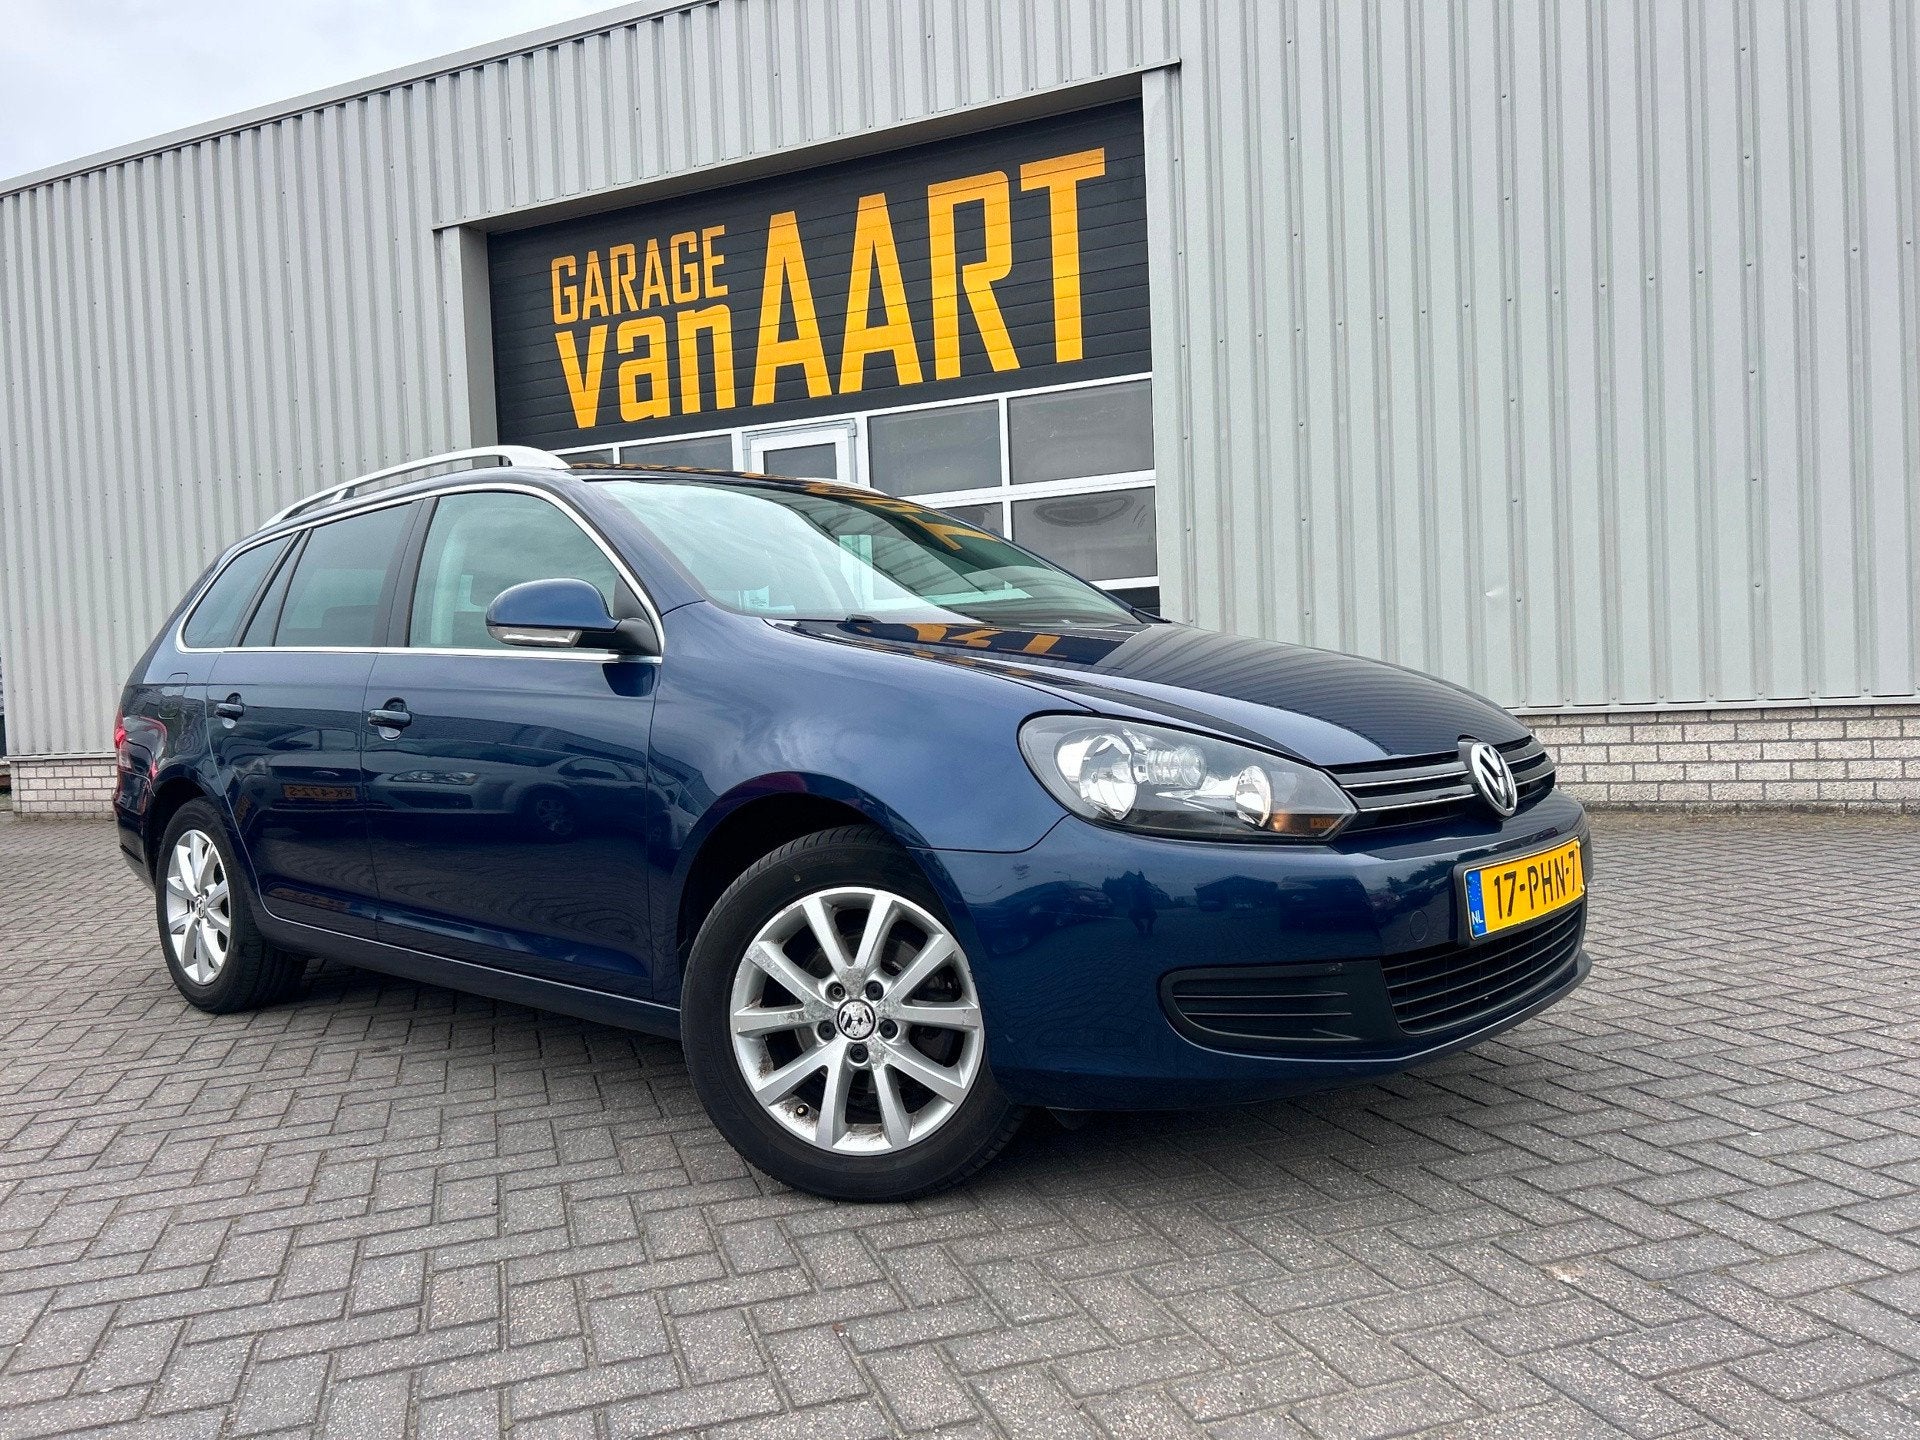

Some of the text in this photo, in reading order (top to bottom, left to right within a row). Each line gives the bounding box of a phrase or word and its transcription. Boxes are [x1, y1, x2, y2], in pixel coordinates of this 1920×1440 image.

[551, 224, 728, 325] GARAGE
[554, 147, 1105, 429] van AART
[1471, 911, 1483, 925] NL
[1493, 850, 1575, 919] 17-PHN-7
